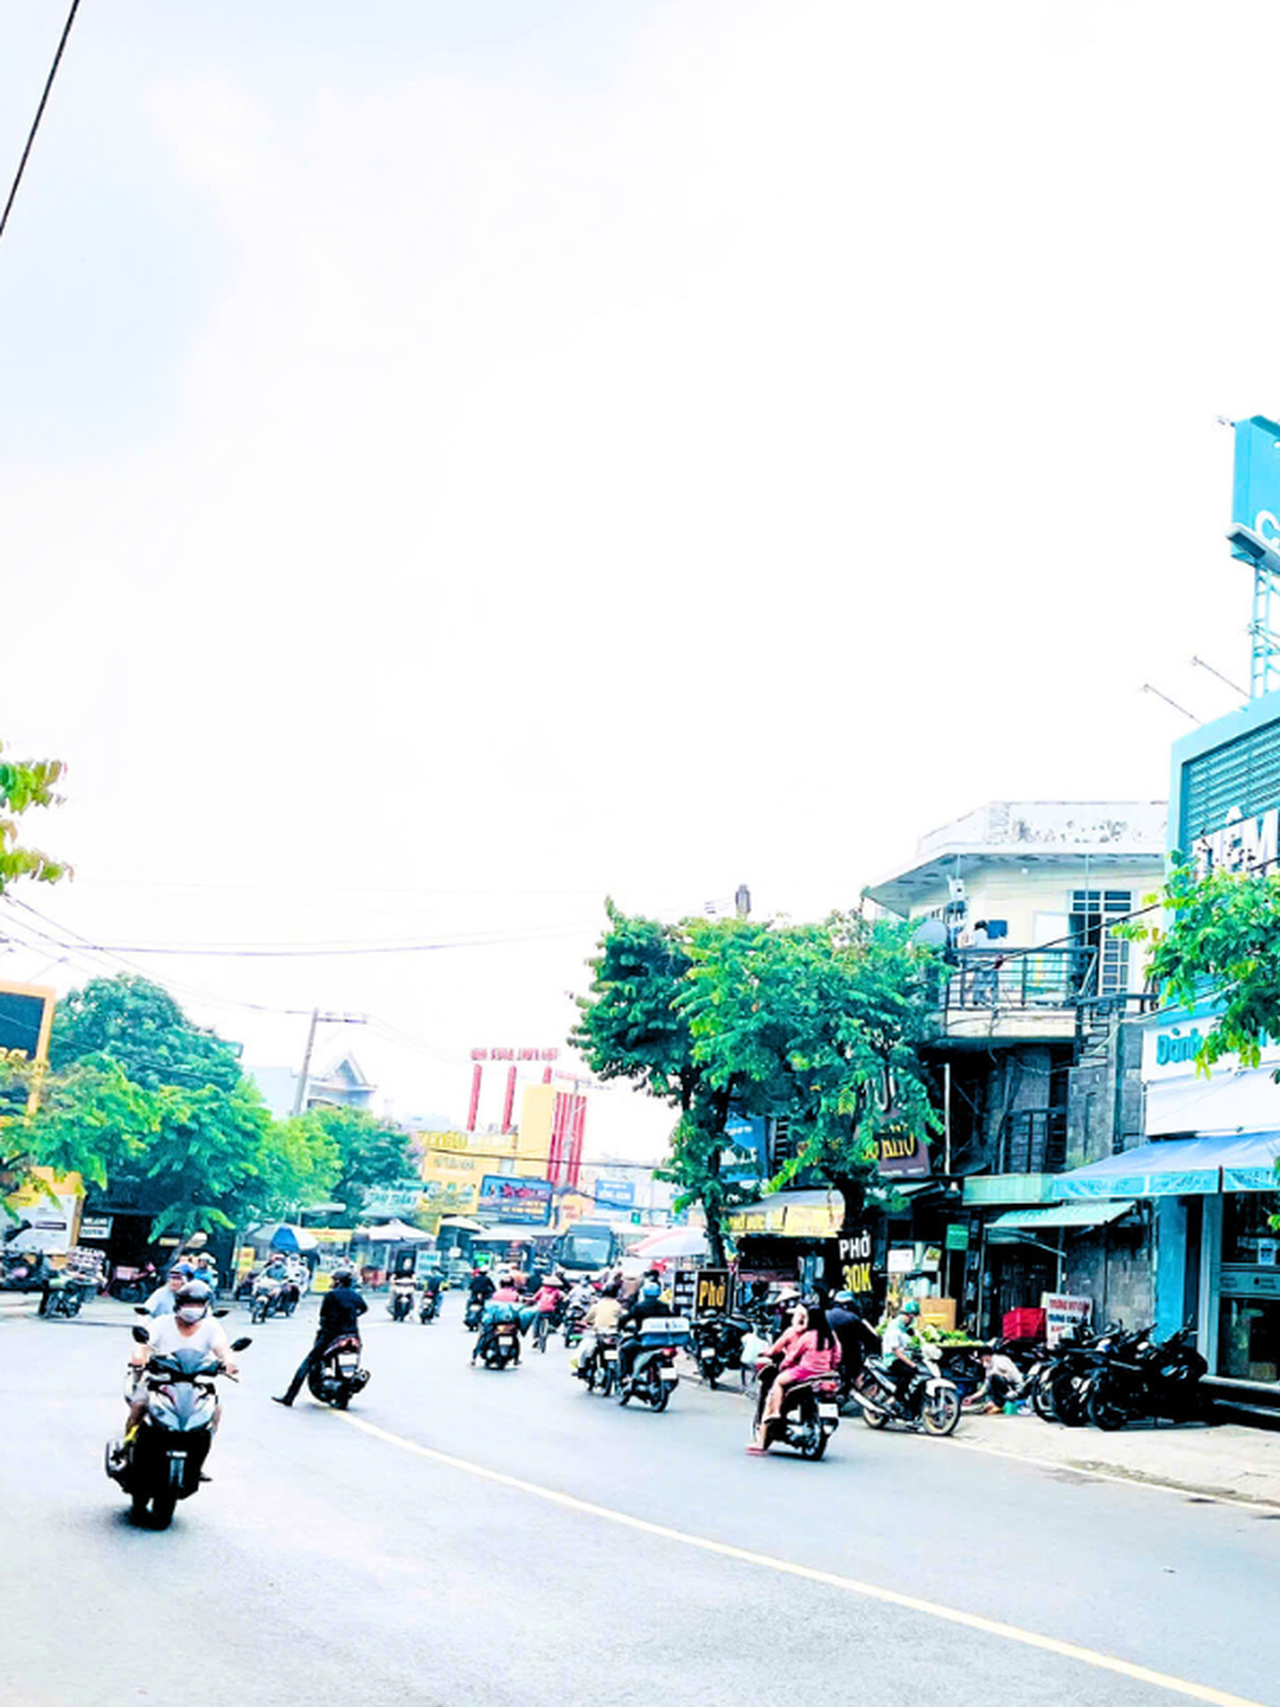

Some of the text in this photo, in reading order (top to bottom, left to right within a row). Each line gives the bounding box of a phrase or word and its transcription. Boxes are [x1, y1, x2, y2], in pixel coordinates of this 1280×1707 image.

[839, 1230, 871, 1260] PHỞ
[699, 1275, 727, 1307] Phở
[842, 1263, 872, 1293] 30K
